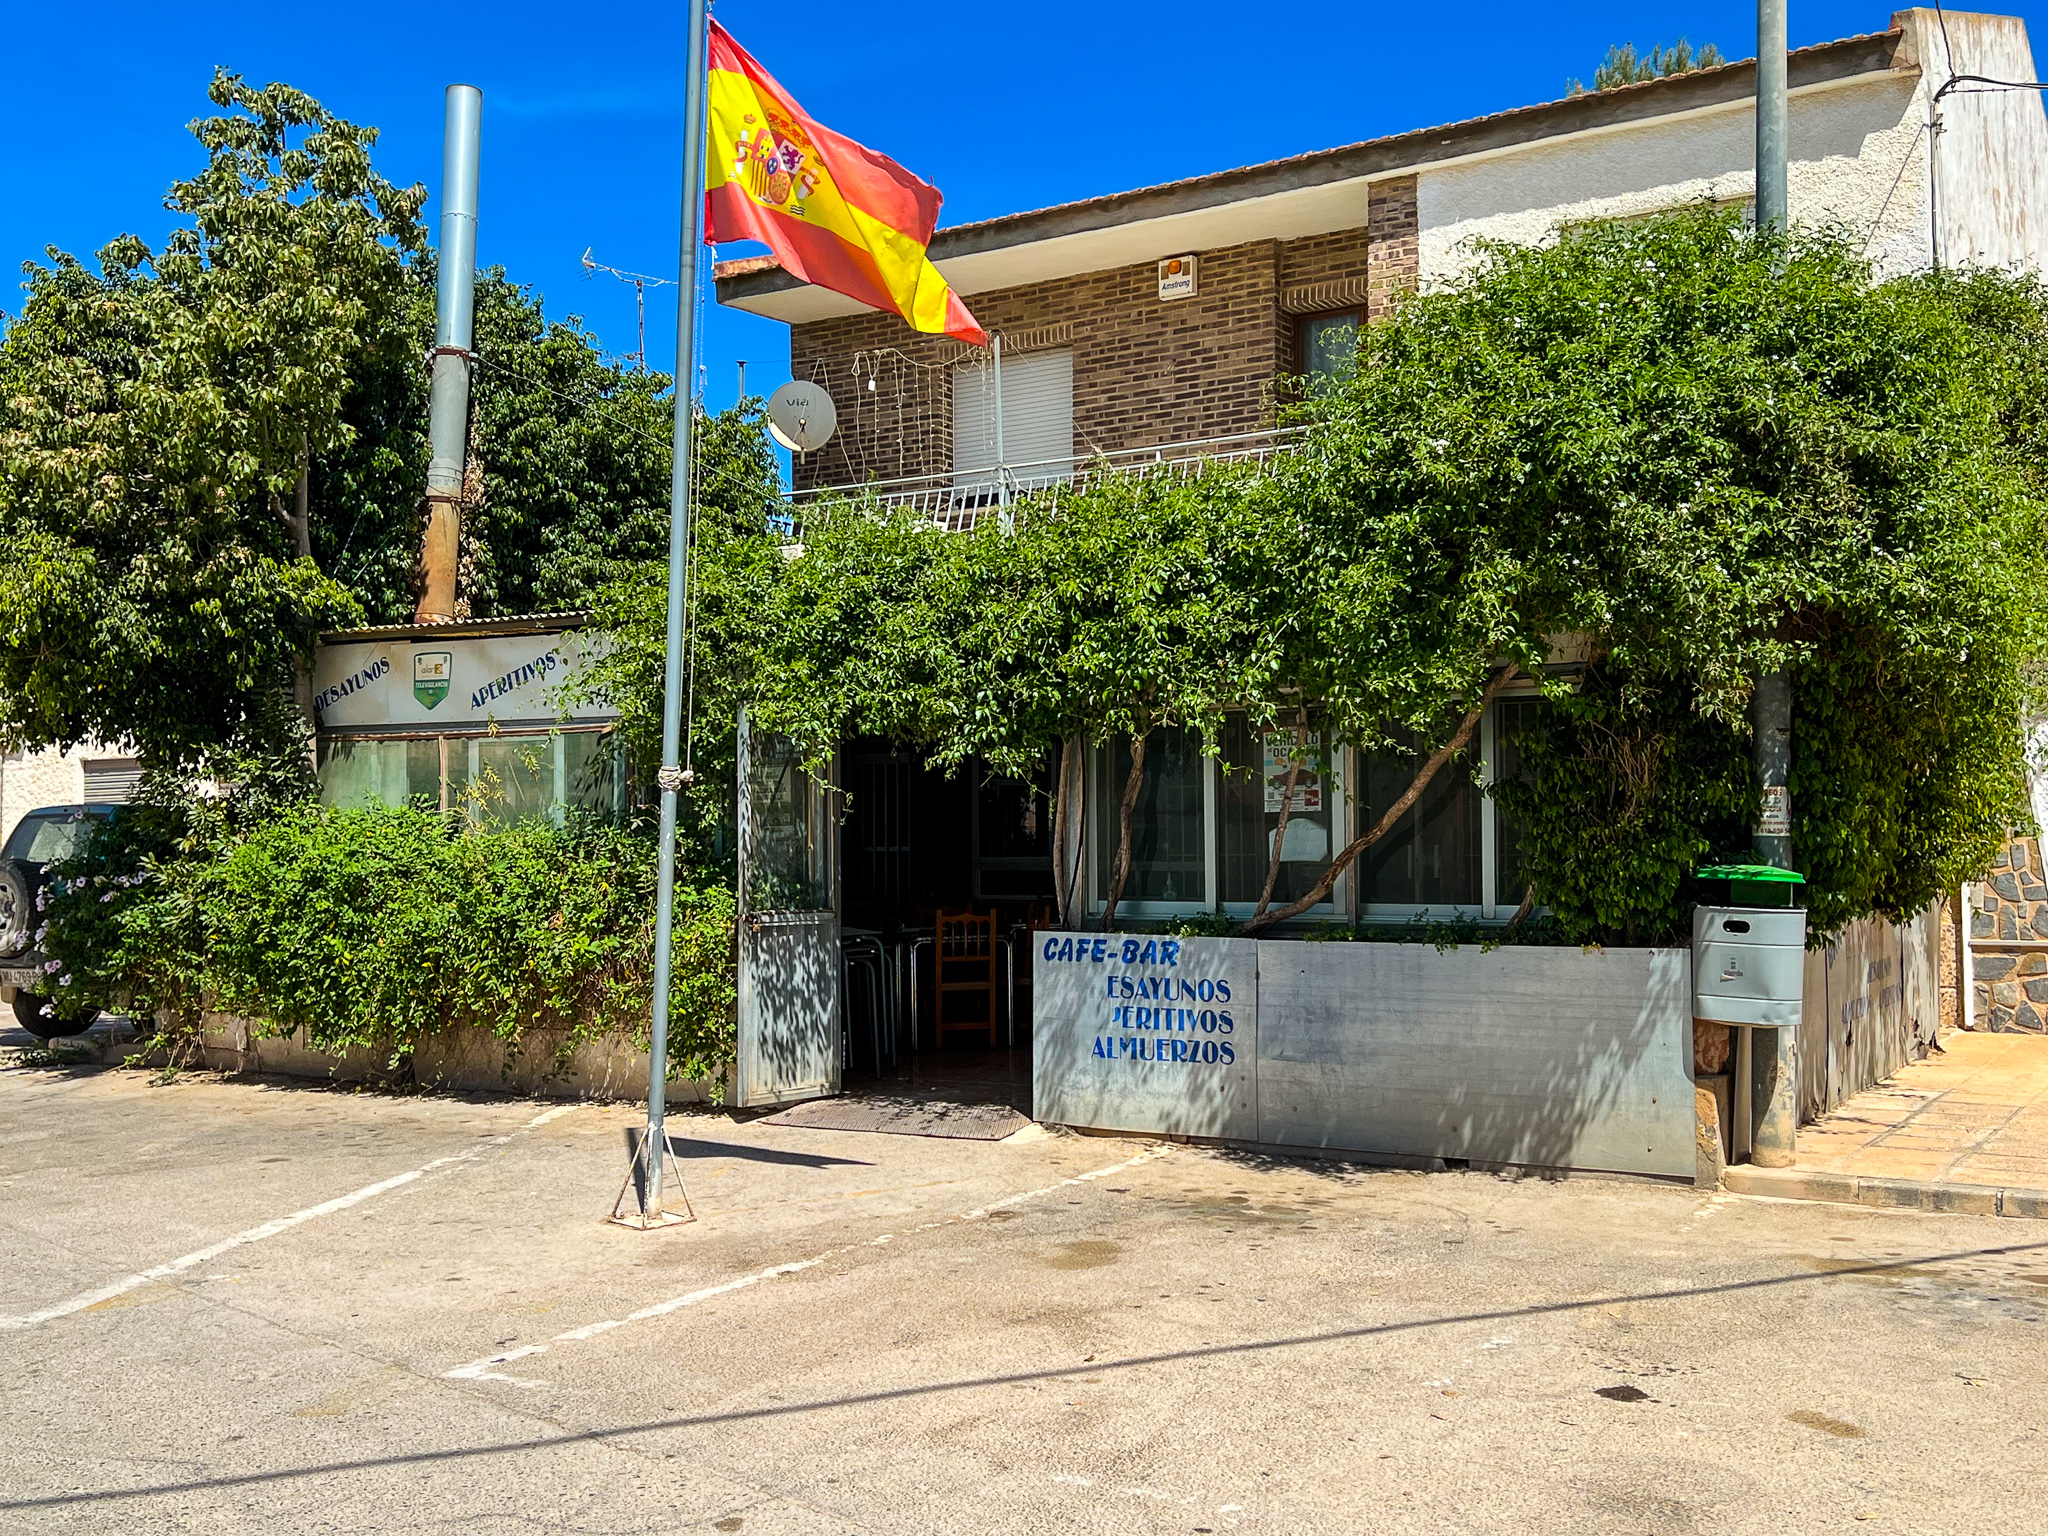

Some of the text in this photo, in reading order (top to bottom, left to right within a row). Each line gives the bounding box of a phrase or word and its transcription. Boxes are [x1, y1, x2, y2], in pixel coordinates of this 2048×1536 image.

[1161, 280, 1190, 291] Amstrong
[313, 656, 390, 713] DESAYUNOS
[471, 651, 556, 711] APERITIVOS
[1043, 937, 1180, 967] CAFE-BAR
[1090, 1036, 1236, 1065] ALMUERZOS
